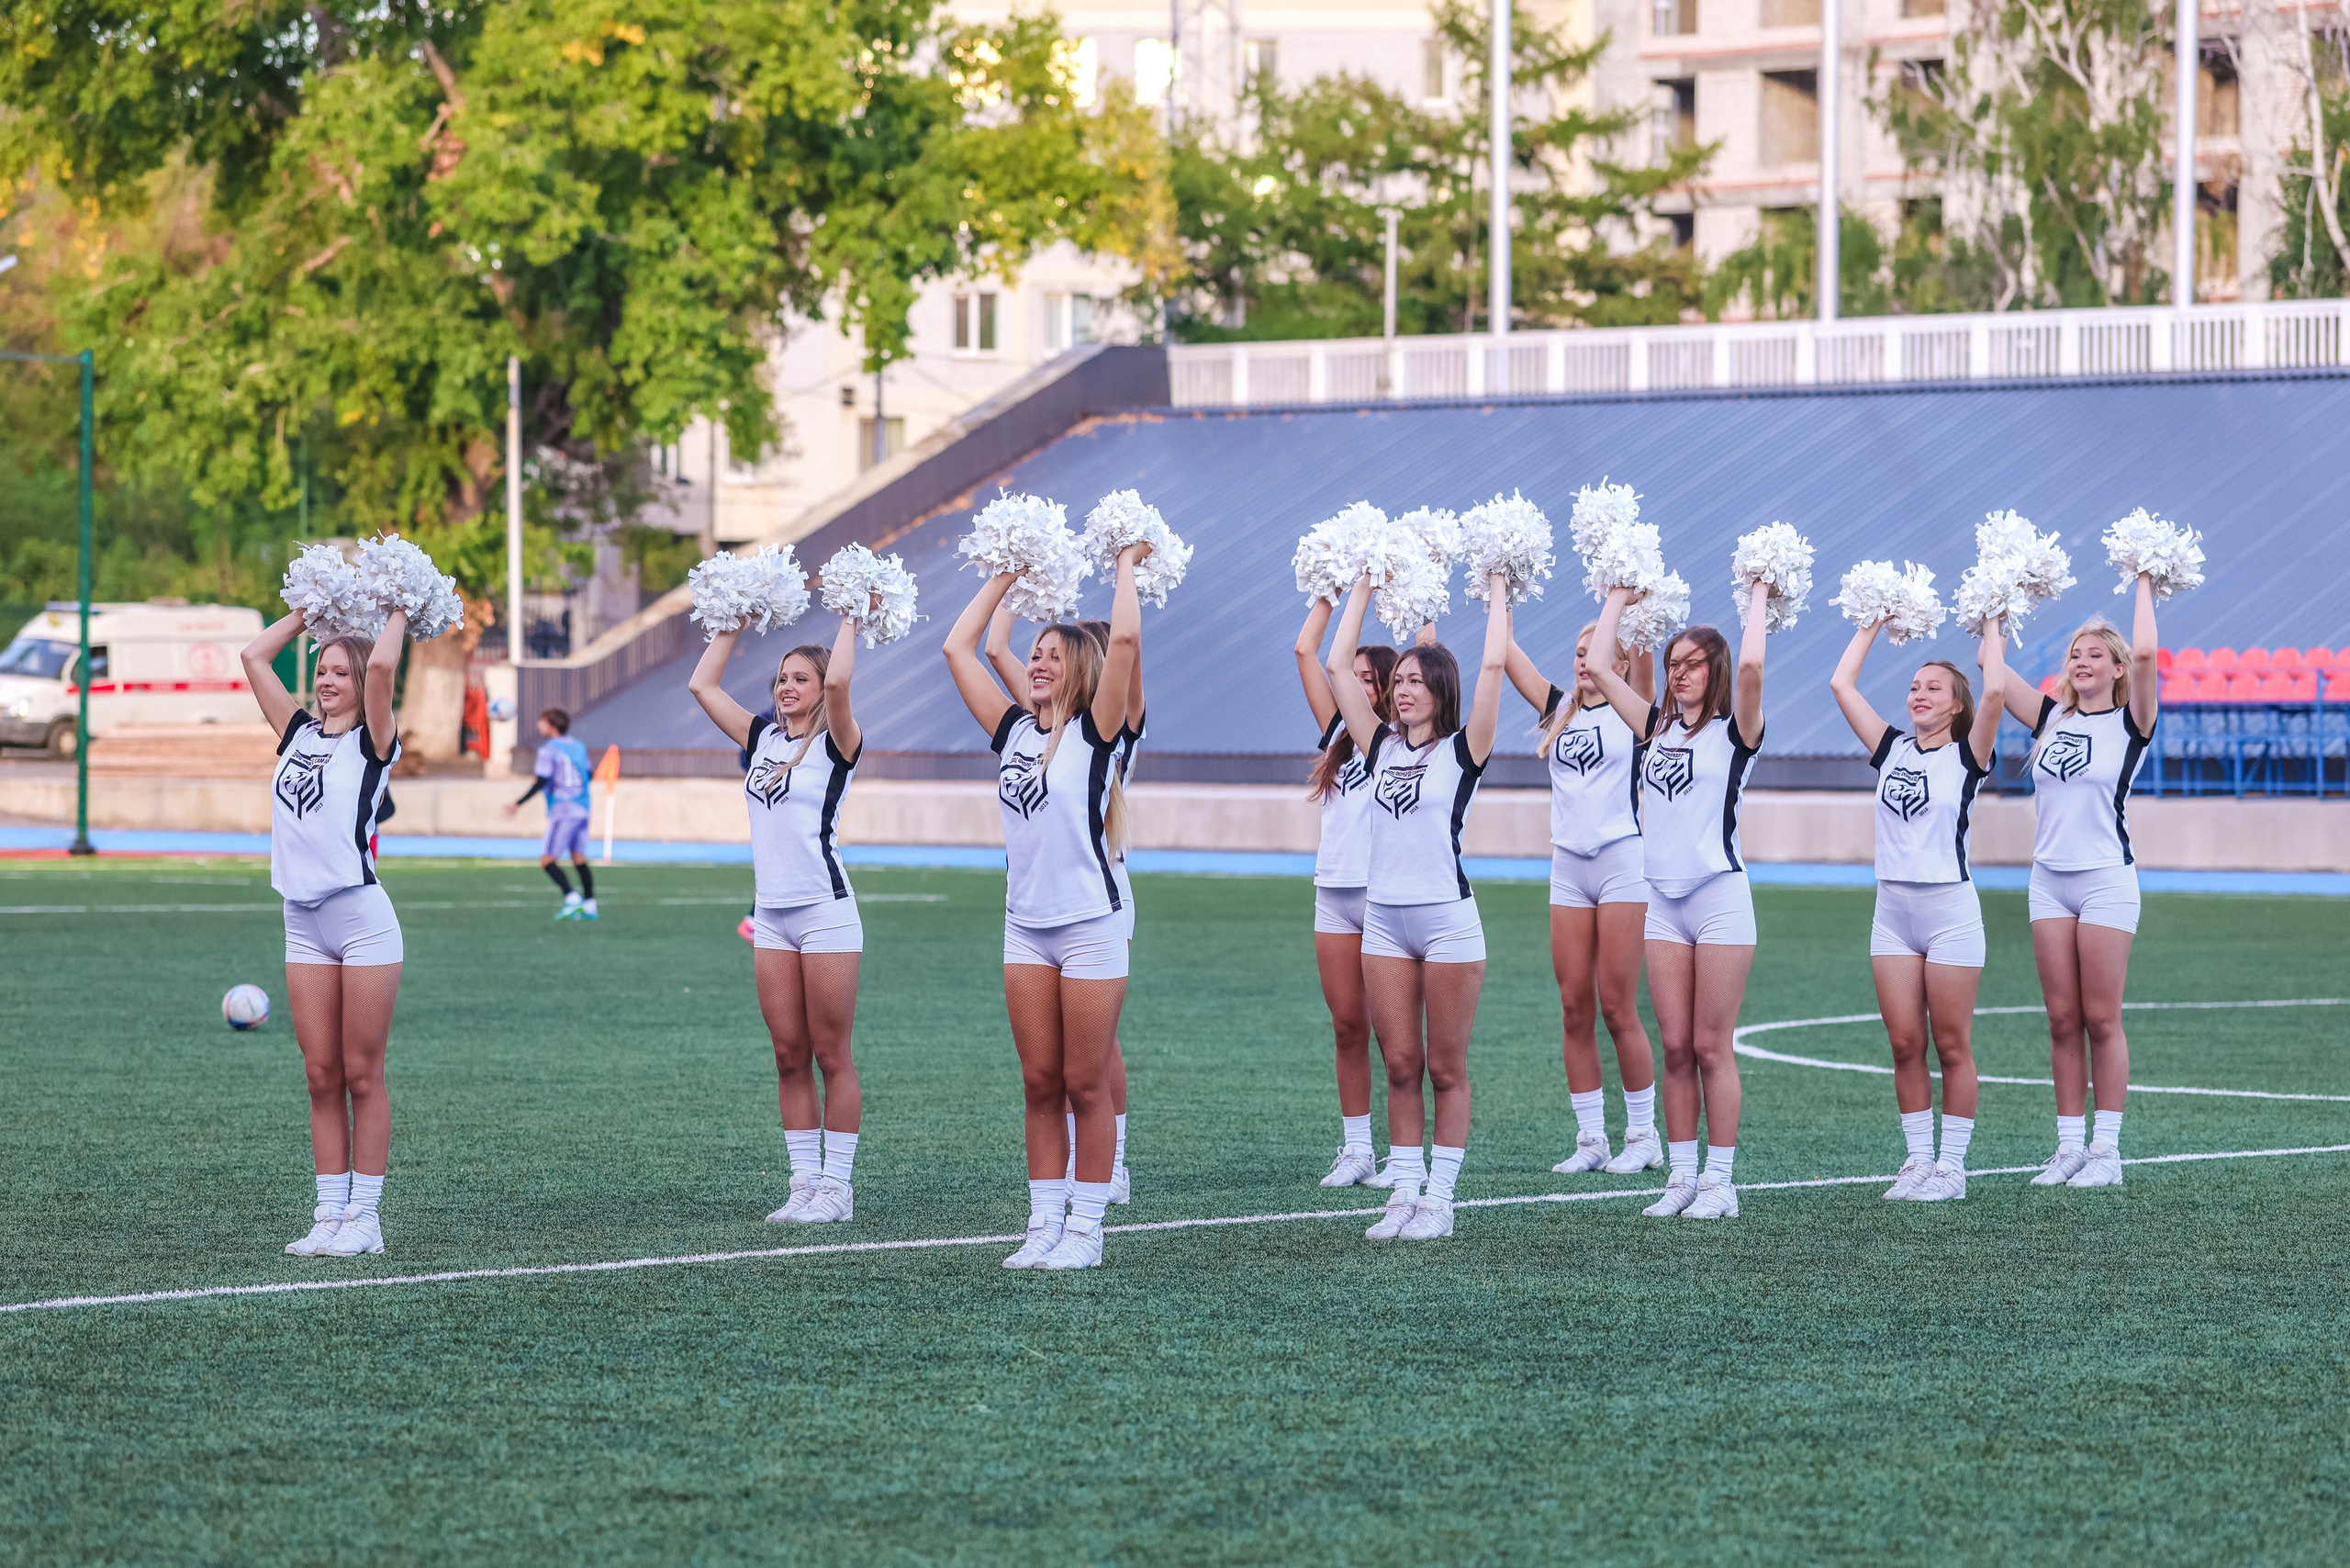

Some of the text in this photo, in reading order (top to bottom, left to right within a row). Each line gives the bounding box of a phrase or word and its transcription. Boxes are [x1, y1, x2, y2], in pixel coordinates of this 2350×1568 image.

[2077, 768, 2089, 778] 2015
[1358, 782, 1370, 791] 2015
[1683, 786, 1694, 796] 2015
[314, 802, 324, 813] 2015
[1038, 800, 1049, 812] 2015
[1409, 805, 1419, 815] 2015
[1919, 807, 1929, 817] 2015
